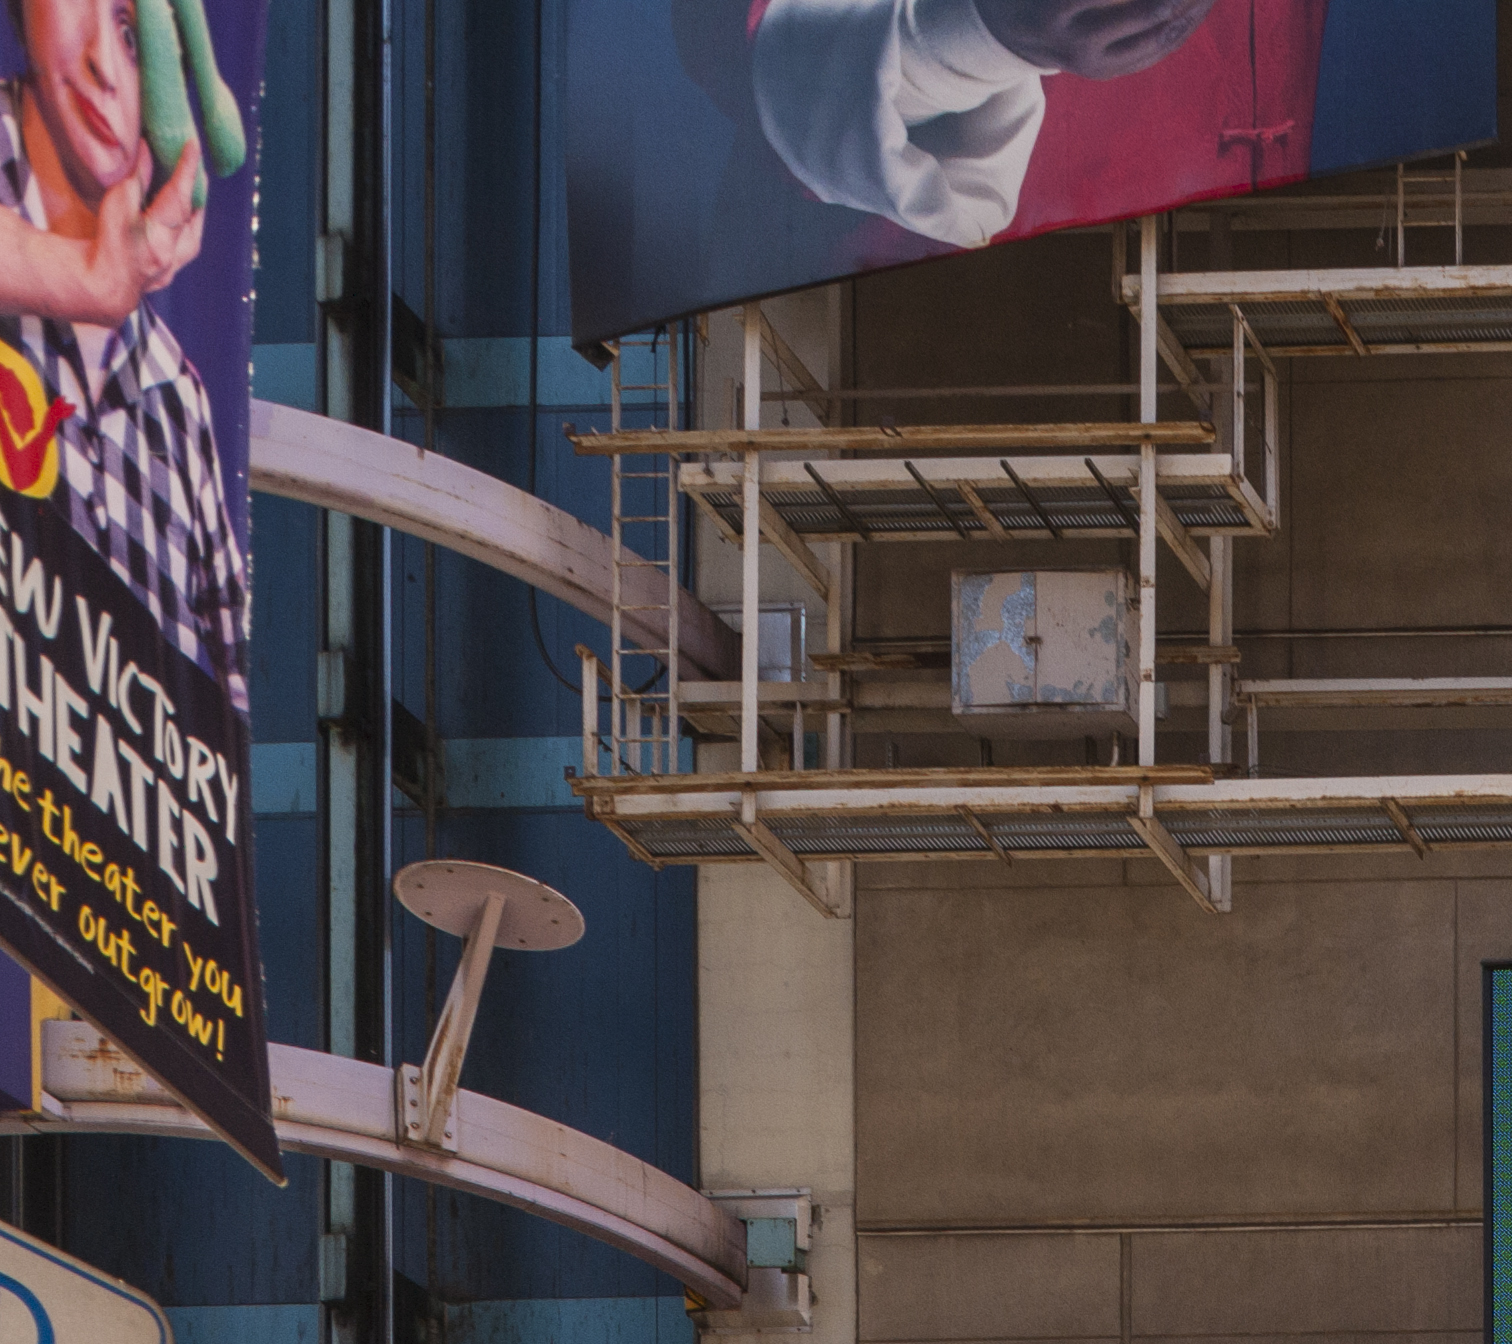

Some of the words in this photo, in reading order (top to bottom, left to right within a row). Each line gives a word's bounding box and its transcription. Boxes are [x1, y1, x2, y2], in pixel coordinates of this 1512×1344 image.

[76, 594, 240, 847] VICTORY
[40, 796, 177, 948] theater
[185, 939, 244, 1019] you
